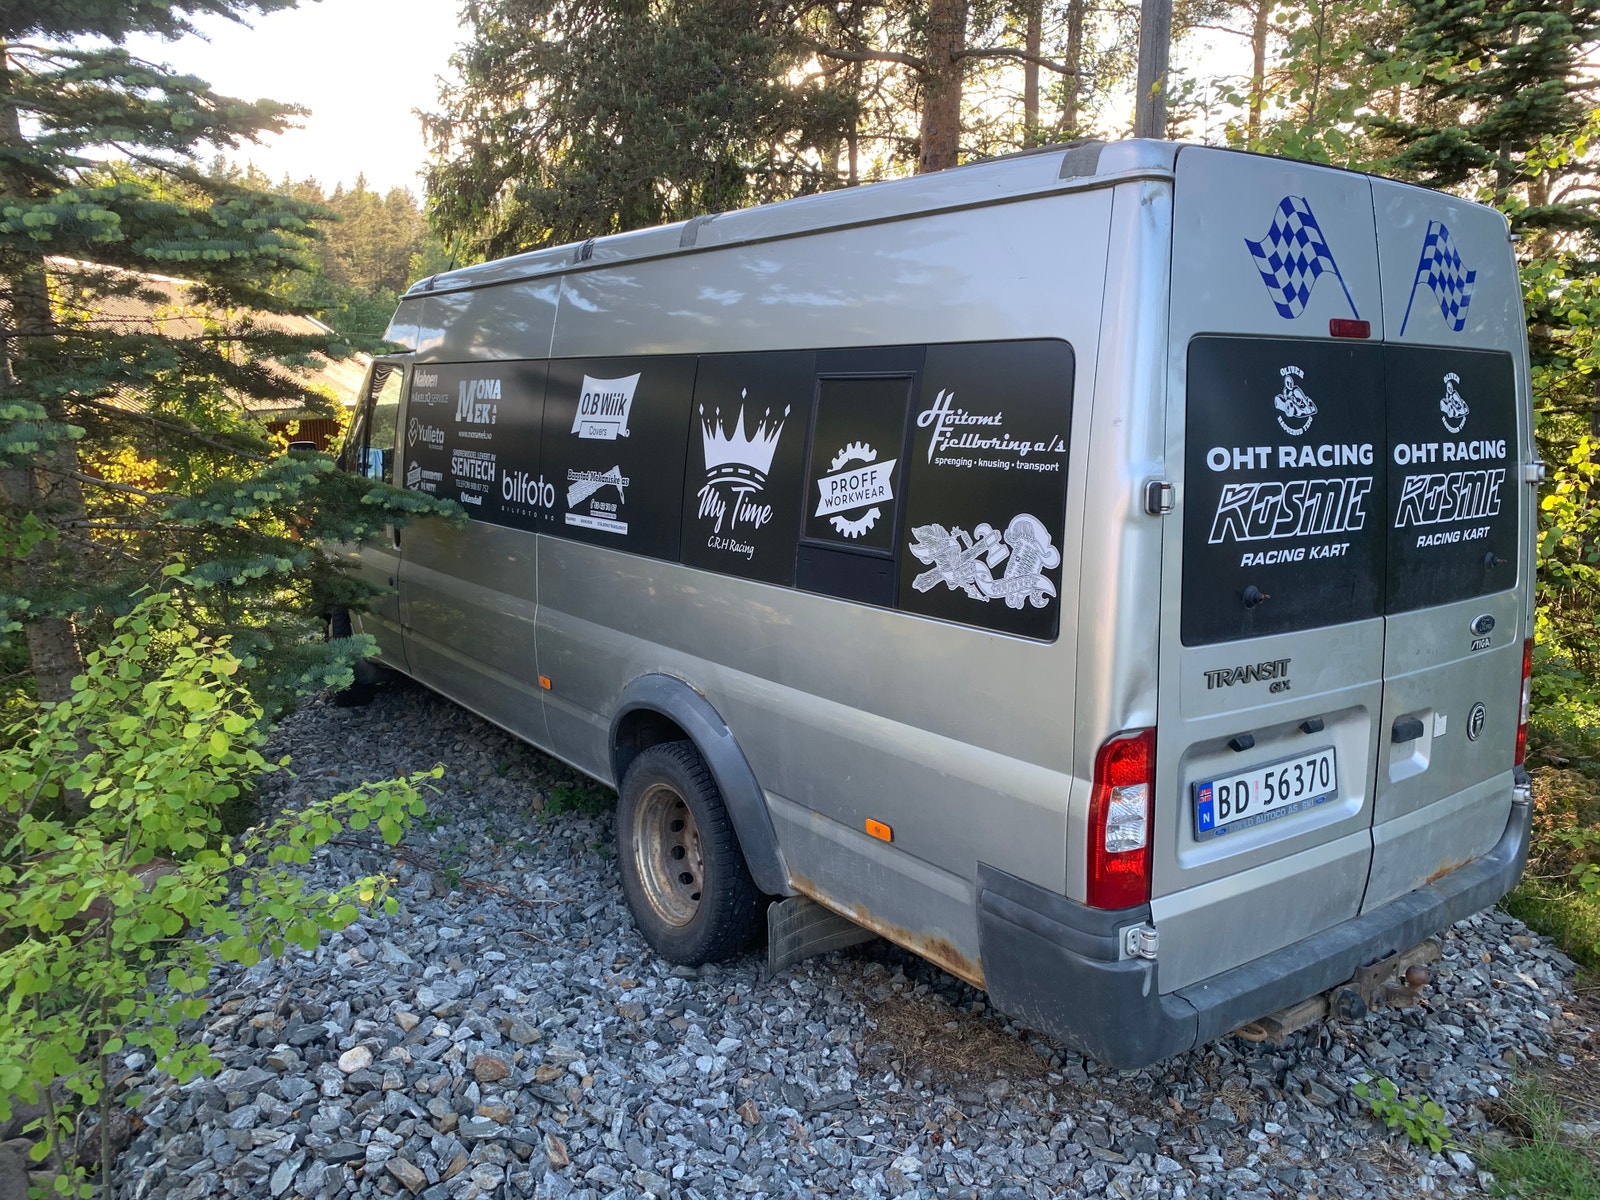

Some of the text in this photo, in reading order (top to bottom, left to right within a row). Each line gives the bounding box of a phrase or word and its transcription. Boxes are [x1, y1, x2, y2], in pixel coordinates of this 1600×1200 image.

[1280, 366, 1304, 379] OLIVER
[588, 426, 607, 437] Covers
[935, 456, 1060, 472] sprenging knusing transport
[1206, 443, 1374, 472] OHT RACING
[1394, 439, 1506, 465] OHT RACING
[451, 456, 496, 482] SENTECH
[502, 469, 555, 509] bilfoto
[831, 470, 877, 495] PROFF
[824, 485, 885, 508] WORKWEAR
[697, 484, 773, 534] My Time
[1416, 526, 1490, 548] RACING KART
[729, 539, 755, 560] Racing
[1240, 543, 1350, 567] RACING KART
[1204, 658, 1291, 690] TRANSIT
[1269, 680, 1291, 694] GLX
[1218, 756, 1330, 820] BD 56370
[1203, 812, 1210, 823] N
[1256, 809, 1286, 824] AUTOCO
[1288, 804, 1298, 814] AS
[1302, 799, 1314, 810] SKI
